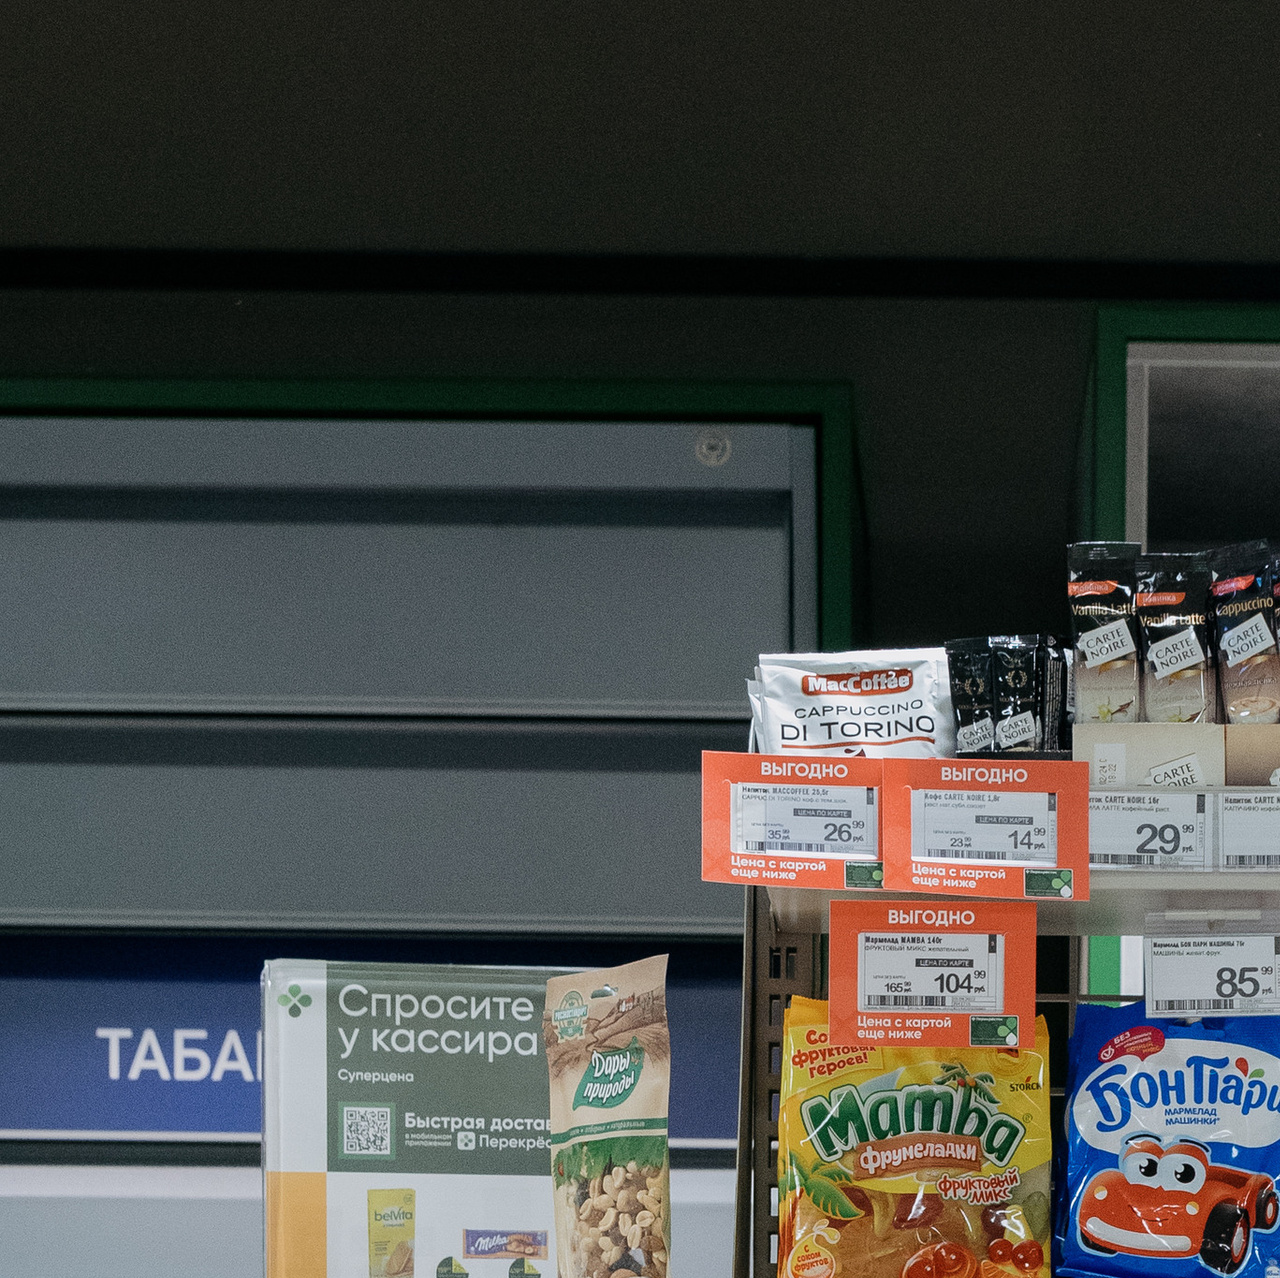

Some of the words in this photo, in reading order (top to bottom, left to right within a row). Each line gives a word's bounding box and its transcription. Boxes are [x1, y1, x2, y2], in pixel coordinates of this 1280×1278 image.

[1216, 596, 1274, 618] Cappuccino
[1154, 637, 1194, 661] CARTE
[1159, 648, 1199, 671] NOIRE
[808, 670, 910, 694] MacCoffee
[794, 699, 924, 719] CAPPUCCINO
[781, 723, 808, 741] DI
[814, 715, 936, 740] TORINO
[761, 762, 849, 780] ВЫГОДНО
[941, 766, 1029, 784] ВЫГОДНО
[823, 823, 852, 843] 26
[1008, 829, 1033, 850] 14
[1136, 823, 1181, 855] 29
[731, 855, 766, 869] Цена
[778, 860, 827, 874] картой
[731, 869, 760, 880] еще
[763, 870, 797, 881] ниже
[888, 909, 976, 927] ВЫГОДНО
[933, 972, 973, 994] 104
[1217, 966, 1260, 999] 85
[338, 984, 535, 1025] Спросите
[338, 1028, 359, 1060] у
[373, 1028, 538, 1062] кассира
[591, 1050, 630, 1078] Дары
[808, 1053, 869, 1079] героев!
[338, 1069, 414, 1086] Суперцена
[583, 1070, 635, 1103] природы
[1009, 1081, 1042, 1093] STORCK
[405, 1112, 485, 1132] Быстрая
[1164, 1107, 1218, 1117] МАРМЕЛАД
[1165, 1117, 1218, 1126] МАШИНКИ
[802, 1084, 1025, 1166] Mamba
